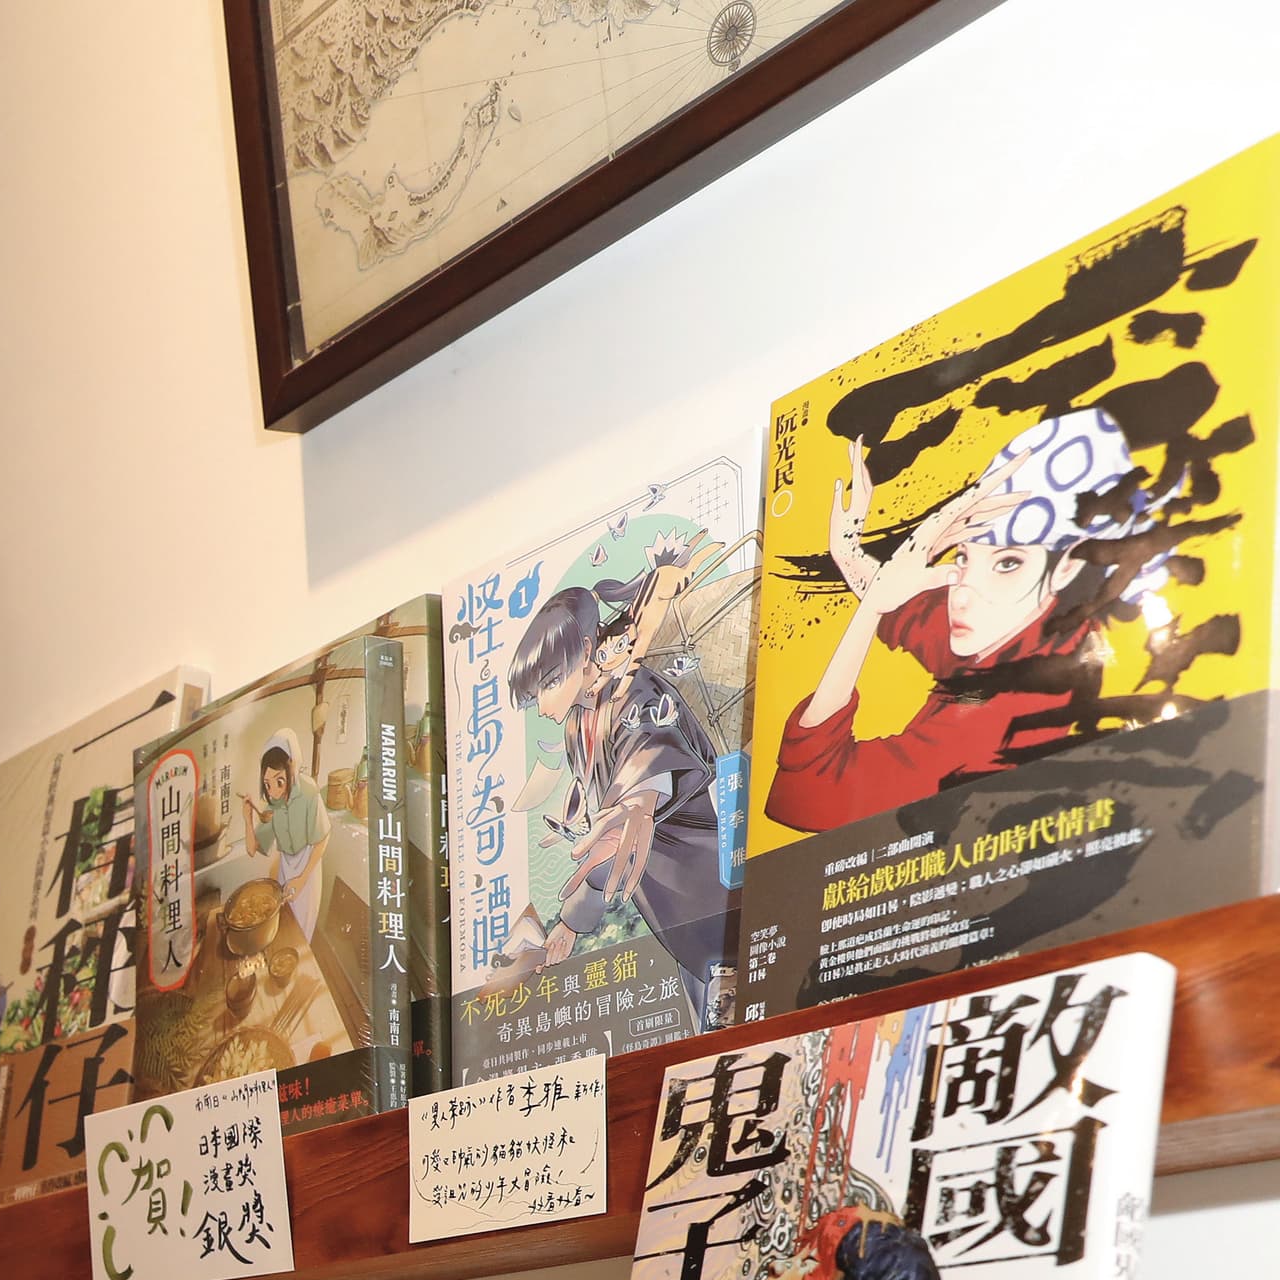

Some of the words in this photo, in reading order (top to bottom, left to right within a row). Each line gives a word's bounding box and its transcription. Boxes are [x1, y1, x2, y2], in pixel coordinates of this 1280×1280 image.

[772, 407, 798, 494] 阮光民
[380, 723, 398, 802] MARARUM
[726, 771, 747, 868] 張季雅
[821, 797, 1116, 911] 獻給戲班職人的時代情書
[160, 785, 184, 974] 山間料理人
[376, 813, 407, 974] 山間料理人
[459, 950, 656, 1027] 不死少年與靈貓，
[495, 976, 681, 1045] 奇異島嶼的冒險之旅
[908, 971, 1130, 1269] 敵國
